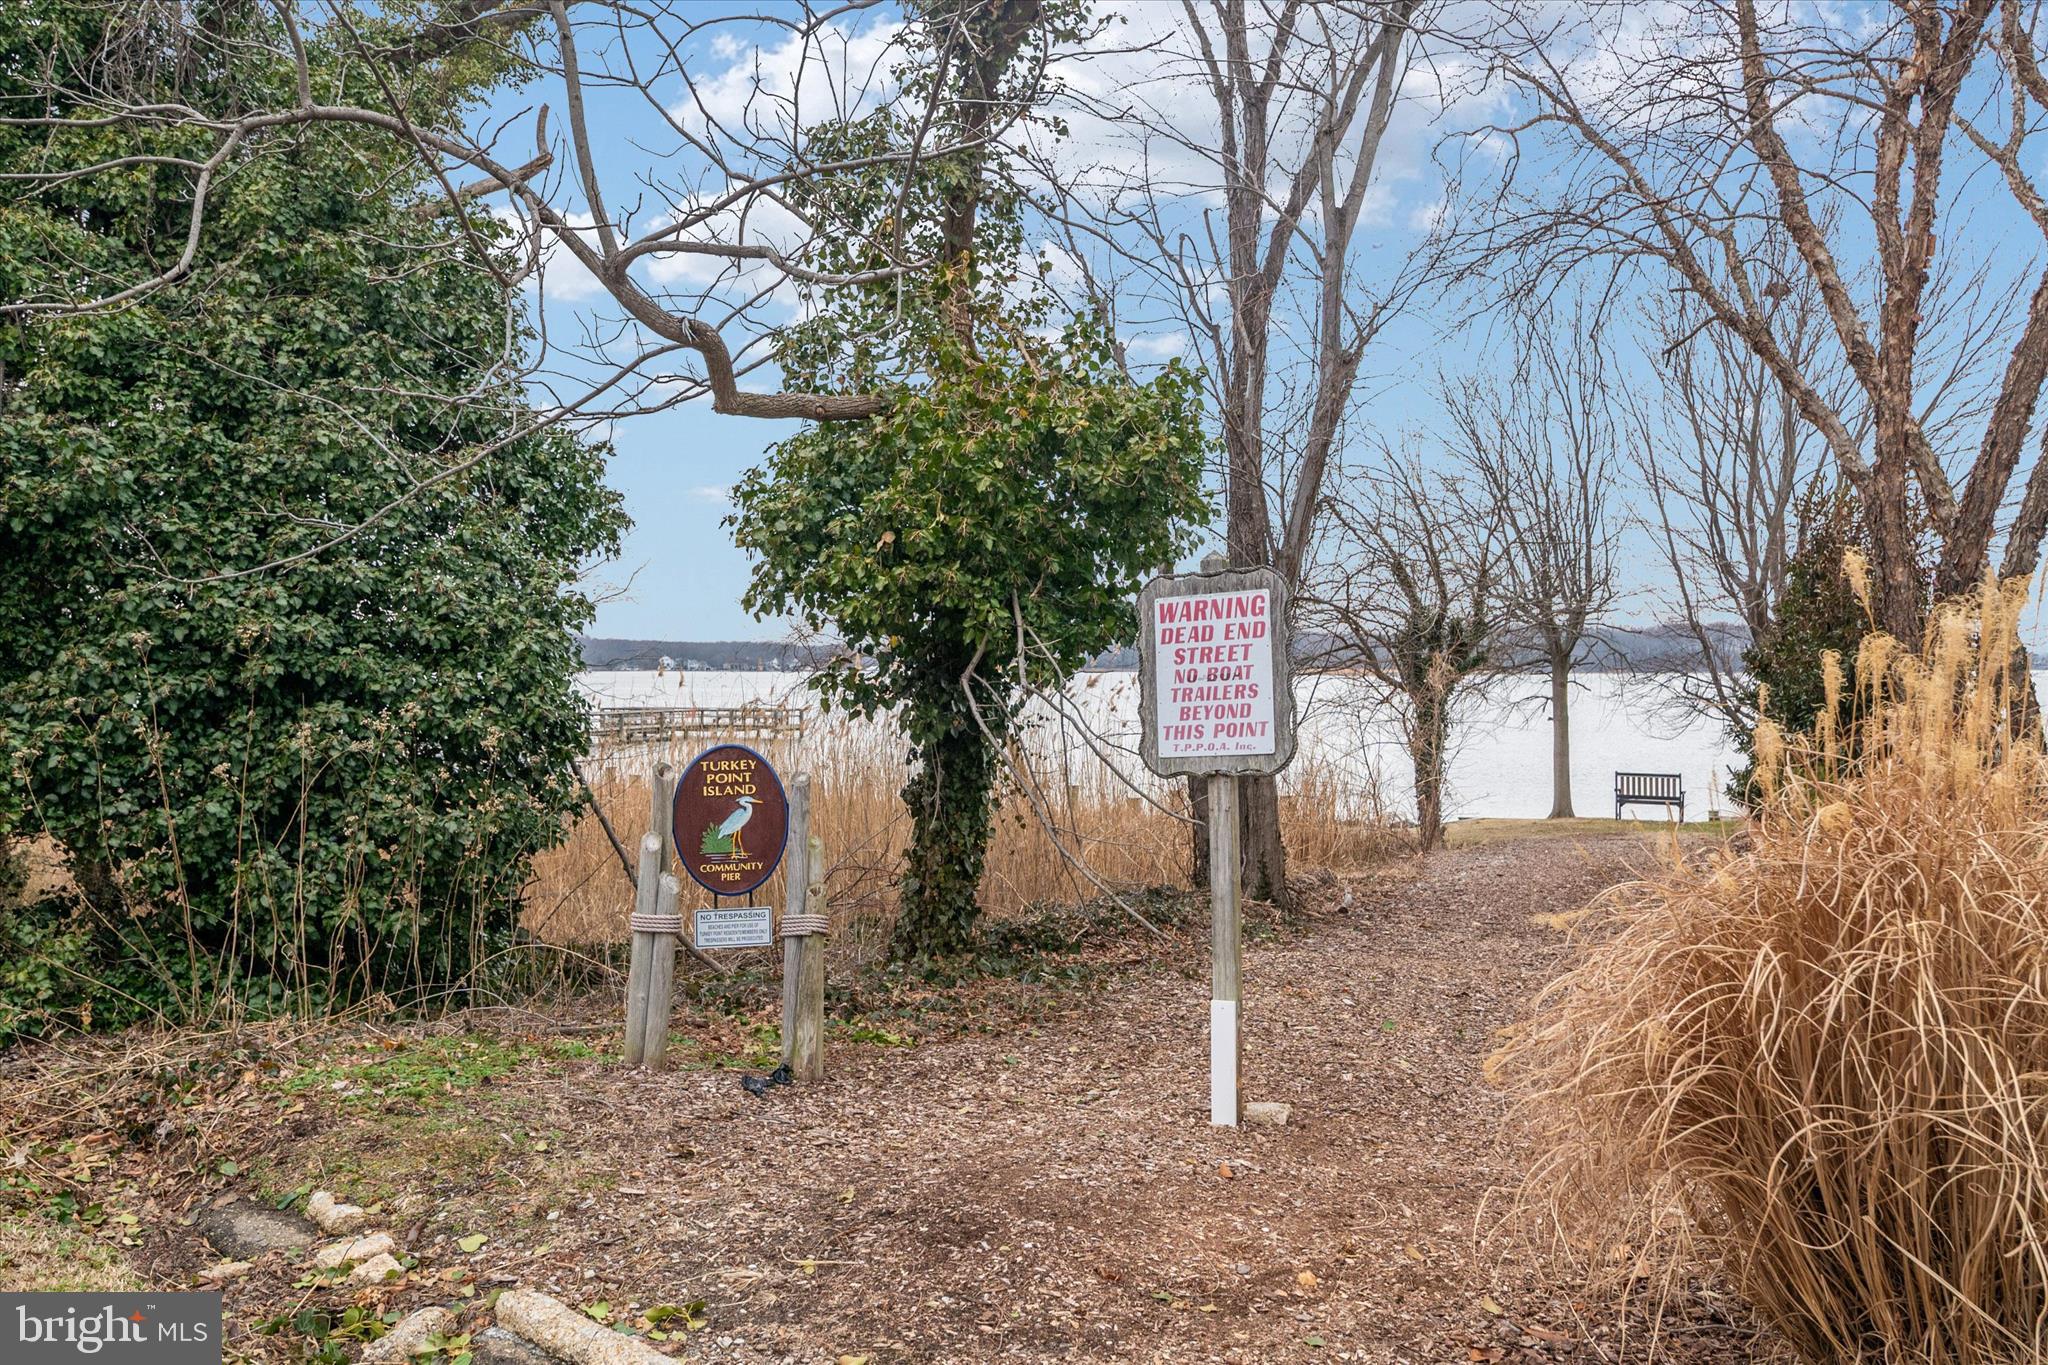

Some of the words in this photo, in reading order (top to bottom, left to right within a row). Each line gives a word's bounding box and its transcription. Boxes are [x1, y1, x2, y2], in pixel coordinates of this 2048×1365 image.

[1159, 595, 1266, 624] WARNING
[1160, 624, 1214, 645] DEAD
[1223, 621, 1266, 641] END
[1174, 643, 1253, 666] STREET
[1174, 668, 1198, 684] NO
[1206, 664, 1254, 682] BOAT
[1170, 683, 1259, 703] TRAILERS
[1179, 702, 1252, 722] BEYOND
[1163, 724, 1205, 741] THIS
[1213, 721, 1269, 739] POINT
[1173, 742, 1230, 753] T.P.P.O.A.
[1235, 742, 1256, 750] Inc.
[700, 759, 757, 771] TURKEY
[706, 772, 752, 784] POINT
[703, 784, 757, 797] ISLAND
[700, 861, 764, 873] COMMUNITY
[721, 872, 741, 881] PIER
[714, 911, 766, 920] TRESPASSING
